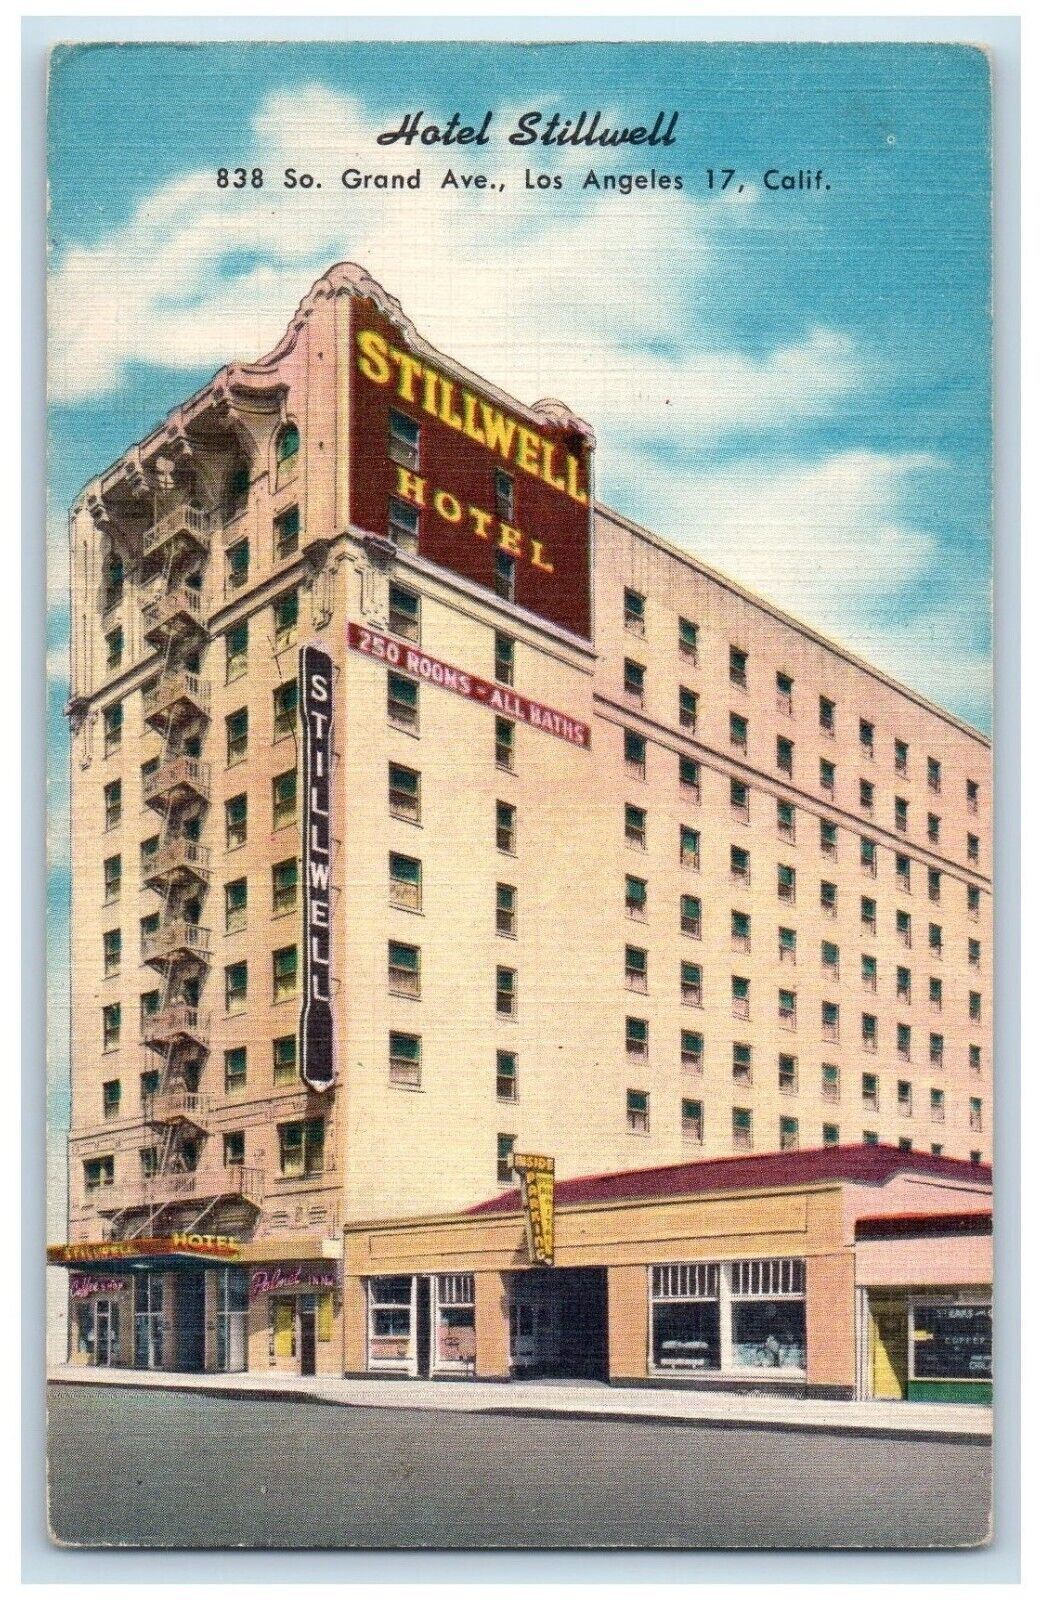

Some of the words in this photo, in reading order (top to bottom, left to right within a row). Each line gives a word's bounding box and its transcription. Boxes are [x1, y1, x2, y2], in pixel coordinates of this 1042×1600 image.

[357, 329, 588, 504] STILLWELL
[396, 466, 555, 574] HOTEL
[358, 630, 400, 663] 250
[406, 650, 472, 694] ROOMS
[490, 688, 525, 721] ALL
[529, 705, 587, 746] BATHS
[308, 672, 330, 1004] STILLWELL
[172, 1232, 240, 1249] HOTEL
